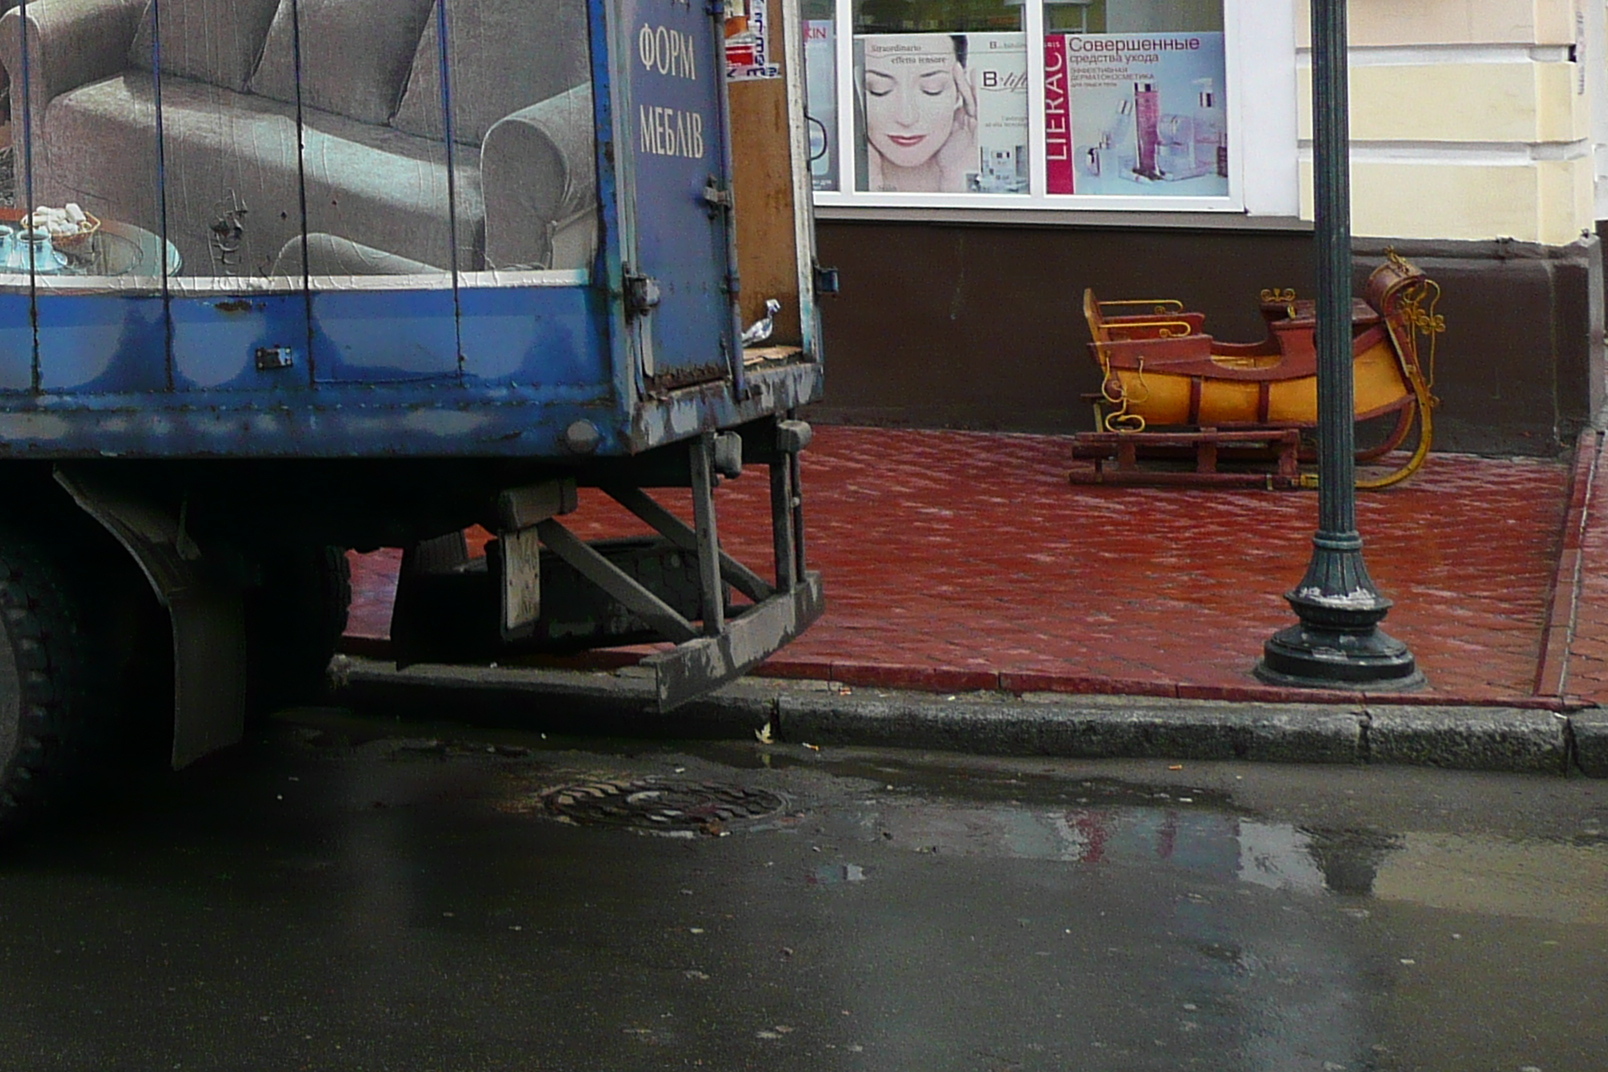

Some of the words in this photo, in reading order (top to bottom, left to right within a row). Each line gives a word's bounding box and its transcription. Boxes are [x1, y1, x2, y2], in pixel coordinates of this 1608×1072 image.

[639, 22, 696, 81] ФОРМ
[1069, 37, 1200, 55] Совершенные
[1069, 54, 1123, 65] средства
[1125, 53, 1159, 64] ухода
[1070, 74, 1155, 82] ДЕРМАТОКОСМЕТИКА
[1045, 52, 1067, 160] LIERAC
[640, 104, 704, 160] МЕБЛІВ
